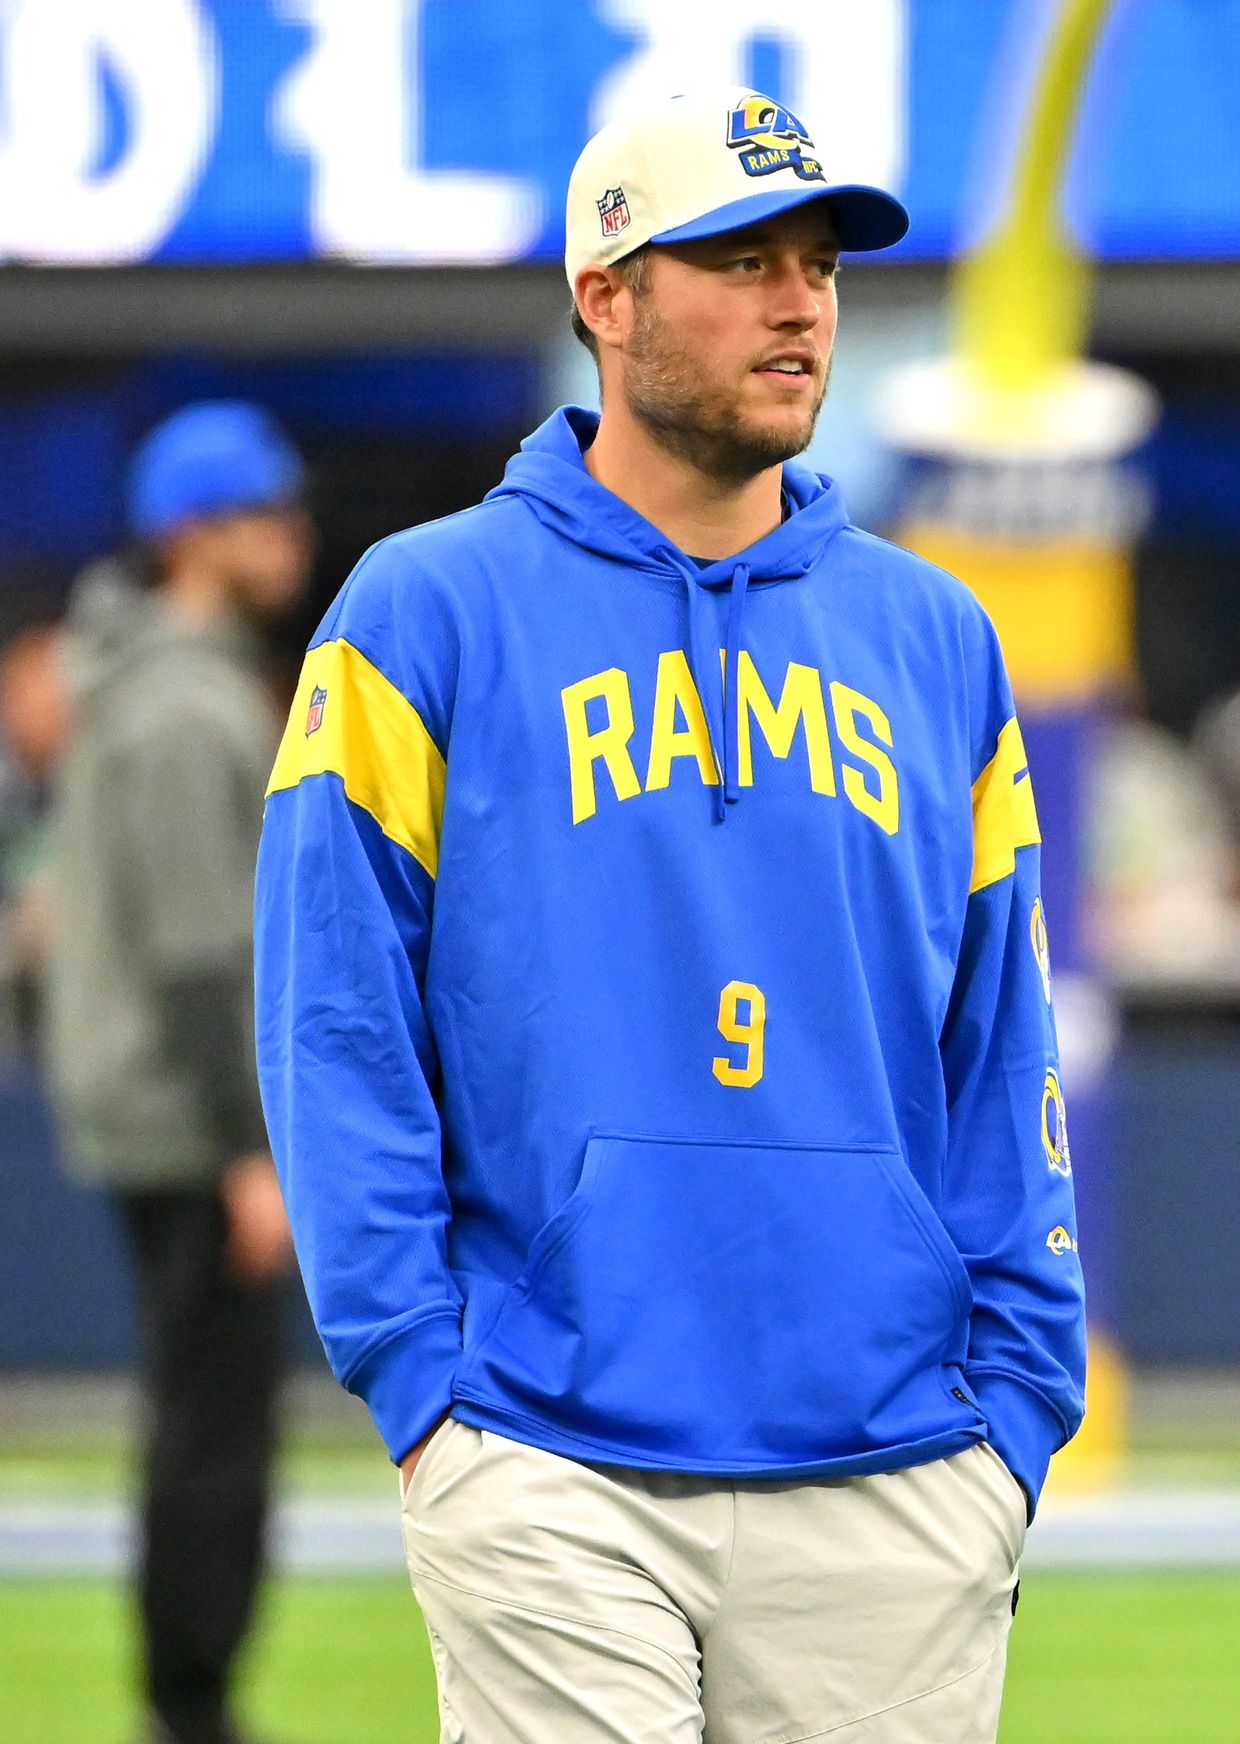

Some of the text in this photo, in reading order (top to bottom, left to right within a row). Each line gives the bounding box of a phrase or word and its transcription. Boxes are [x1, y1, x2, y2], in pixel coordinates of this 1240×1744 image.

[747, 149, 790, 170] RAMS
[604, 206, 628, 233] NFL
[561, 650, 899, 835] RAMS
[712, 981, 766, 1088] 9
